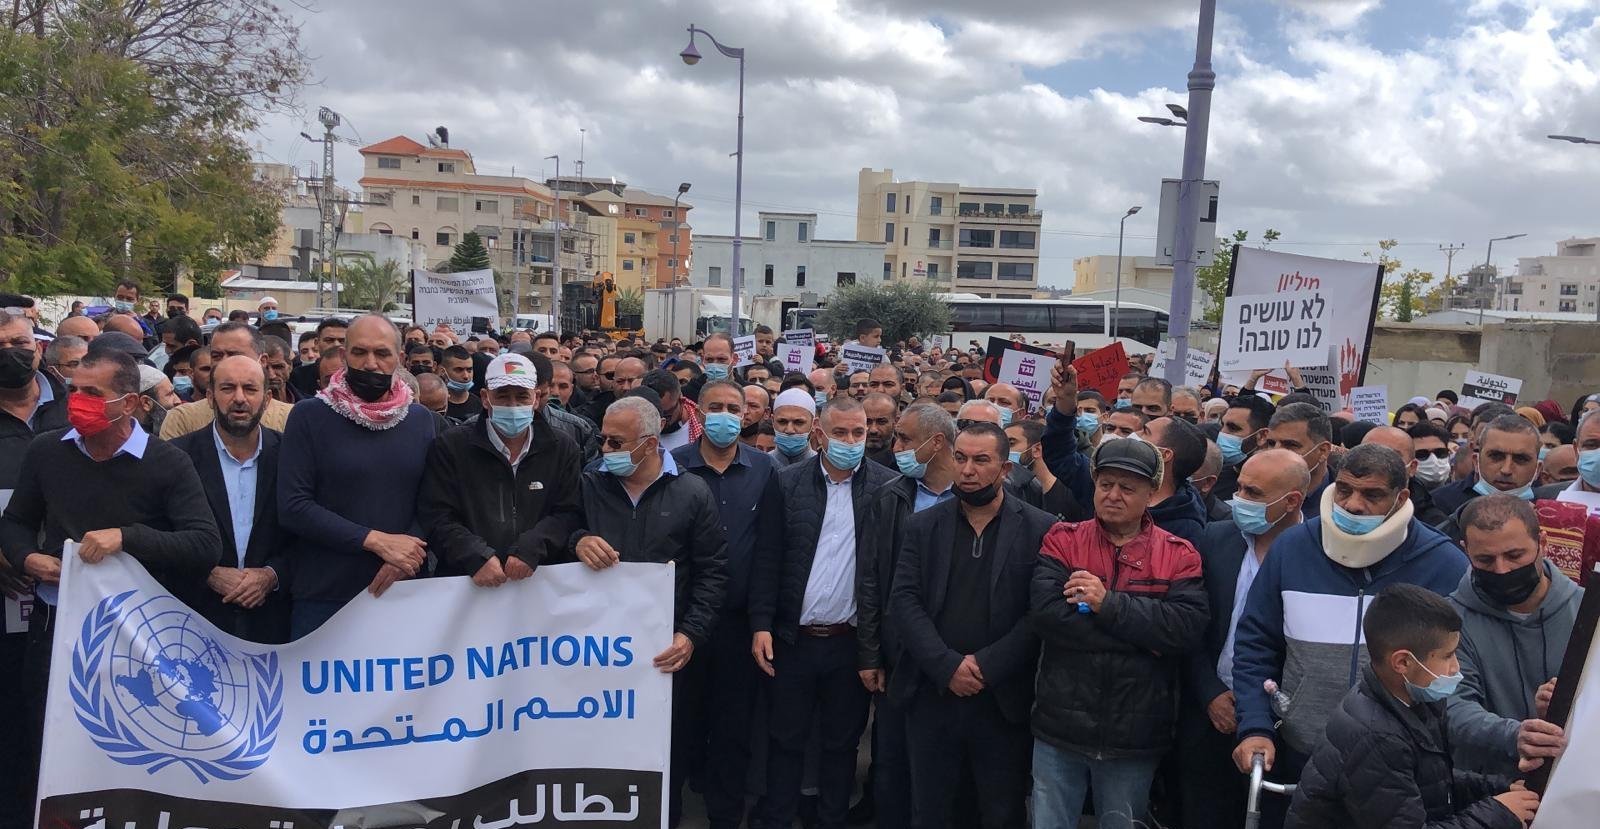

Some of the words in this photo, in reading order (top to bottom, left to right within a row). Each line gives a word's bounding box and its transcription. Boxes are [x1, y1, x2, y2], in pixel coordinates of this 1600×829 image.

[1277, 271, 1320, 293] מיליון
[1239, 300, 1295, 324] עושים
[1300, 292, 1325, 320] לא
[1238, 326, 1291, 353] טובה!
[1296, 321, 1322, 349] לנו
[1020, 365, 1034, 374] נגד
[1021, 357, 1036, 365] ضد
[1011, 378, 1037, 389] العنف
[302, 653, 455, 695] UNITED
[466, 635, 634, 680] NATIONS
[513, 689, 635, 732] الامم
[302, 698, 504, 755] المتحدة
